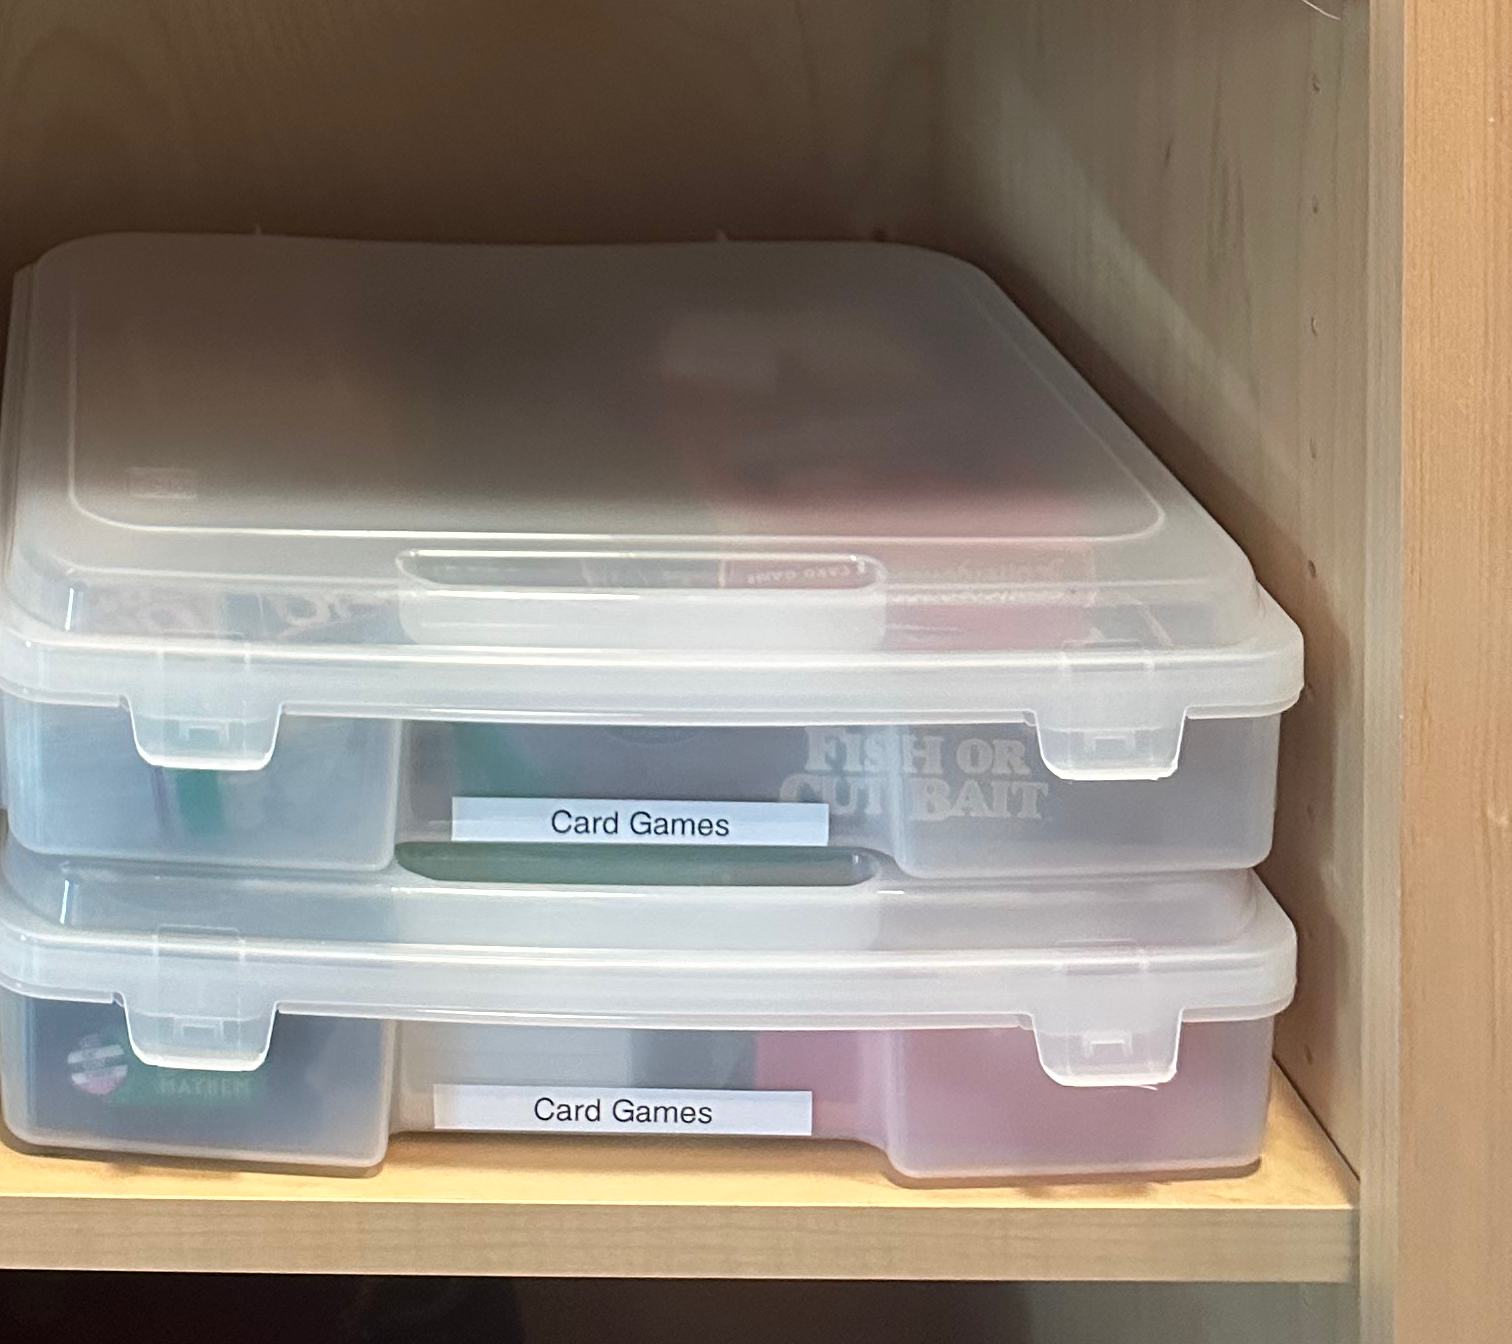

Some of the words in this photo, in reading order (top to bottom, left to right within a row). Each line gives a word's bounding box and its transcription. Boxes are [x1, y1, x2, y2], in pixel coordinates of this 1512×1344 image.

[803, 726, 945, 774] FISH
[955, 737, 1032, 776] OR
[779, 773, 886, 816] CUT
[907, 777, 1049, 821] BAIT
[550, 808, 619, 835] Card
[629, 810, 730, 837] Games
[533, 1096, 602, 1124] Card
[611, 1097, 714, 1126] Games
